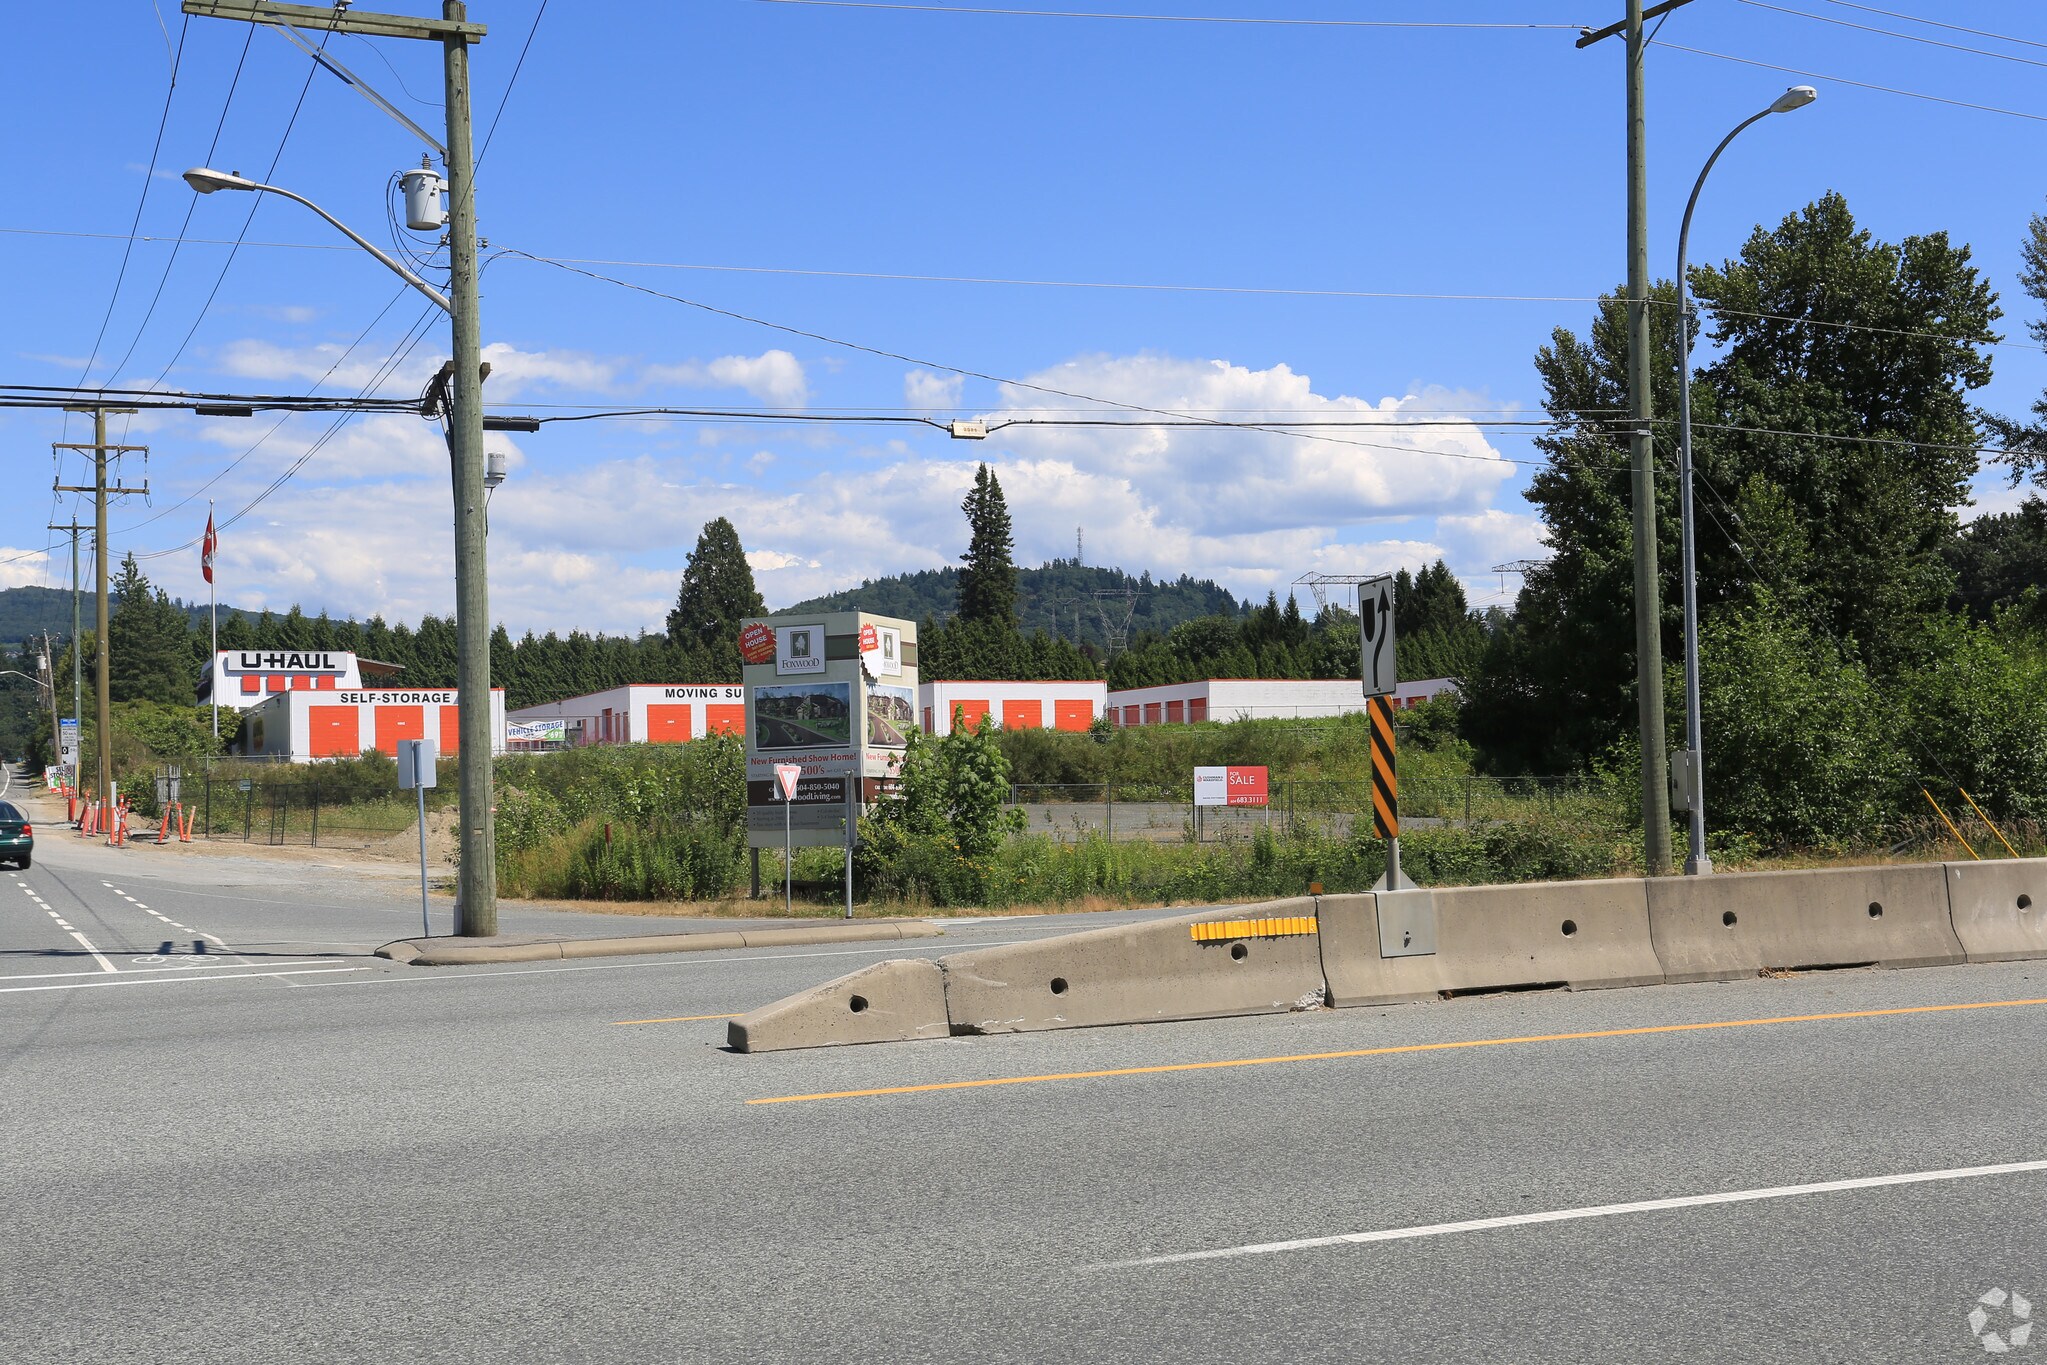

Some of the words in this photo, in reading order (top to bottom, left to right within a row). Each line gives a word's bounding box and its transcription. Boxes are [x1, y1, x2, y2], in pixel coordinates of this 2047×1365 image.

[745, 628, 763, 639] OPEN
[745, 636, 767, 649] HOUSE
[241, 653, 336, 669] U-HAUL
[340, 693, 451, 704] SELF-STORAGE
[665, 688, 718, 698] MOVING
[534, 721, 563, 732] STORAGE
[751, 758, 767, 766] New
[768, 755, 807, 765] Furnished
[809, 754, 829, 763] Show
[831, 752, 857, 762] Home!
[1230, 776, 1255, 785] SALE
[1237, 796, 1262, 804] 683.3111
